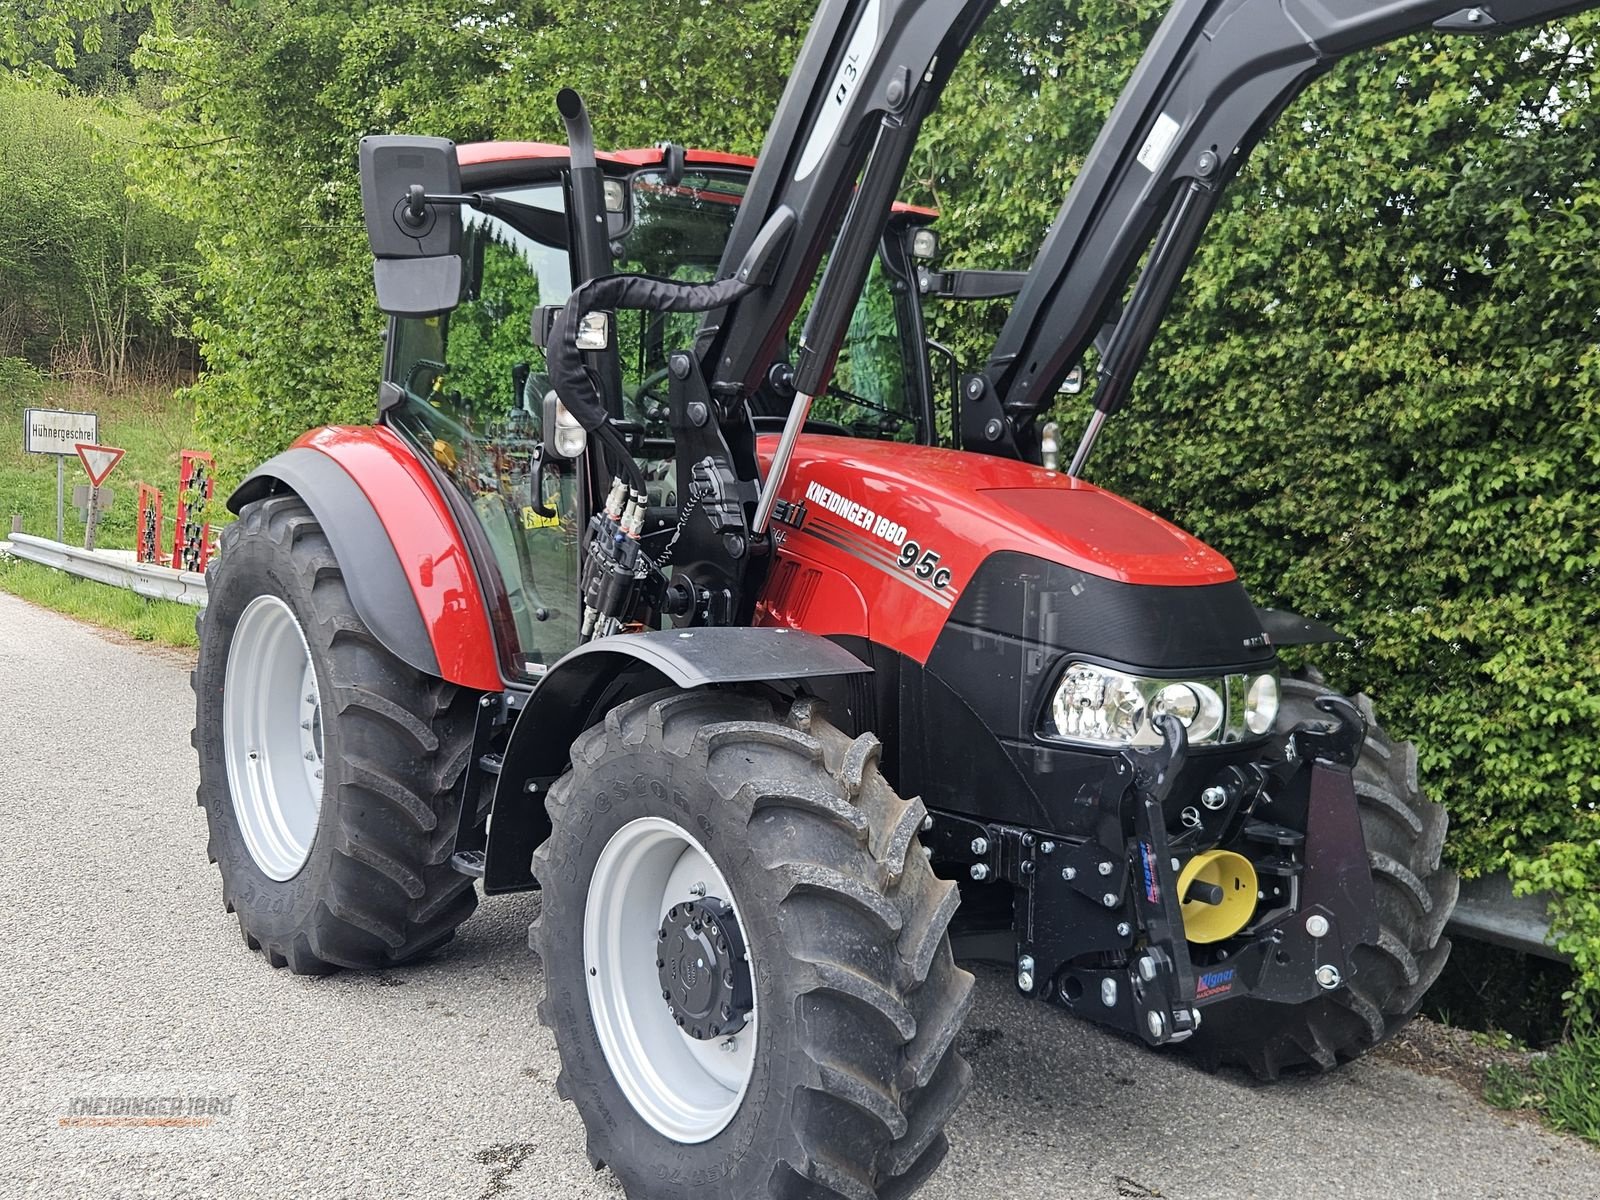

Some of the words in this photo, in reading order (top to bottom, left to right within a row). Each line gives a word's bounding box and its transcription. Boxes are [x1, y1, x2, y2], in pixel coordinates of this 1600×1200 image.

[32, 423, 94, 441] Hühnergeschrei
[805, 480, 875, 531] KNEIDINGER
[871, 515, 907, 547] 1880
